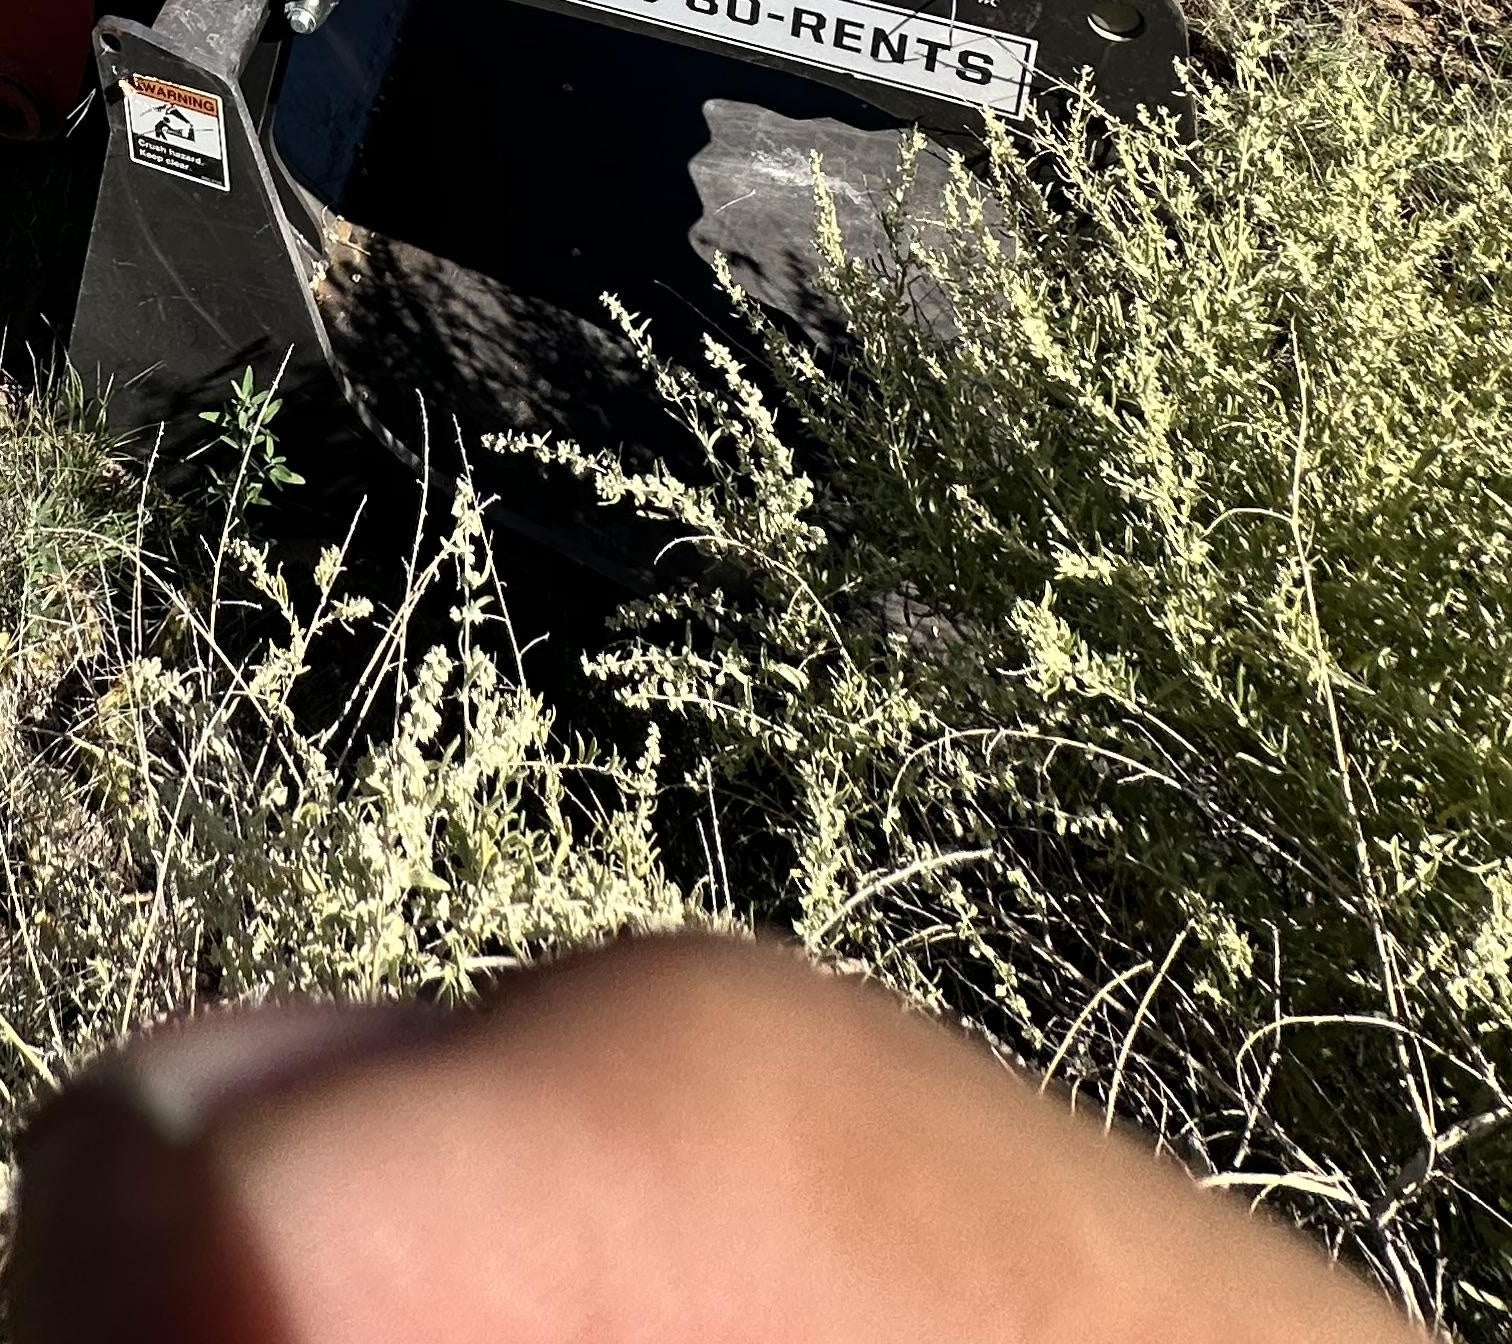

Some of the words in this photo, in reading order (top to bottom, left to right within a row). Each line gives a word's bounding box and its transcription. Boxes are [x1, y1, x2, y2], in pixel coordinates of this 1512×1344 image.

[143, 82, 215, 112] WARNING
[138, 138, 167, 154] Crush
[139, 148, 164, 163] Keep
